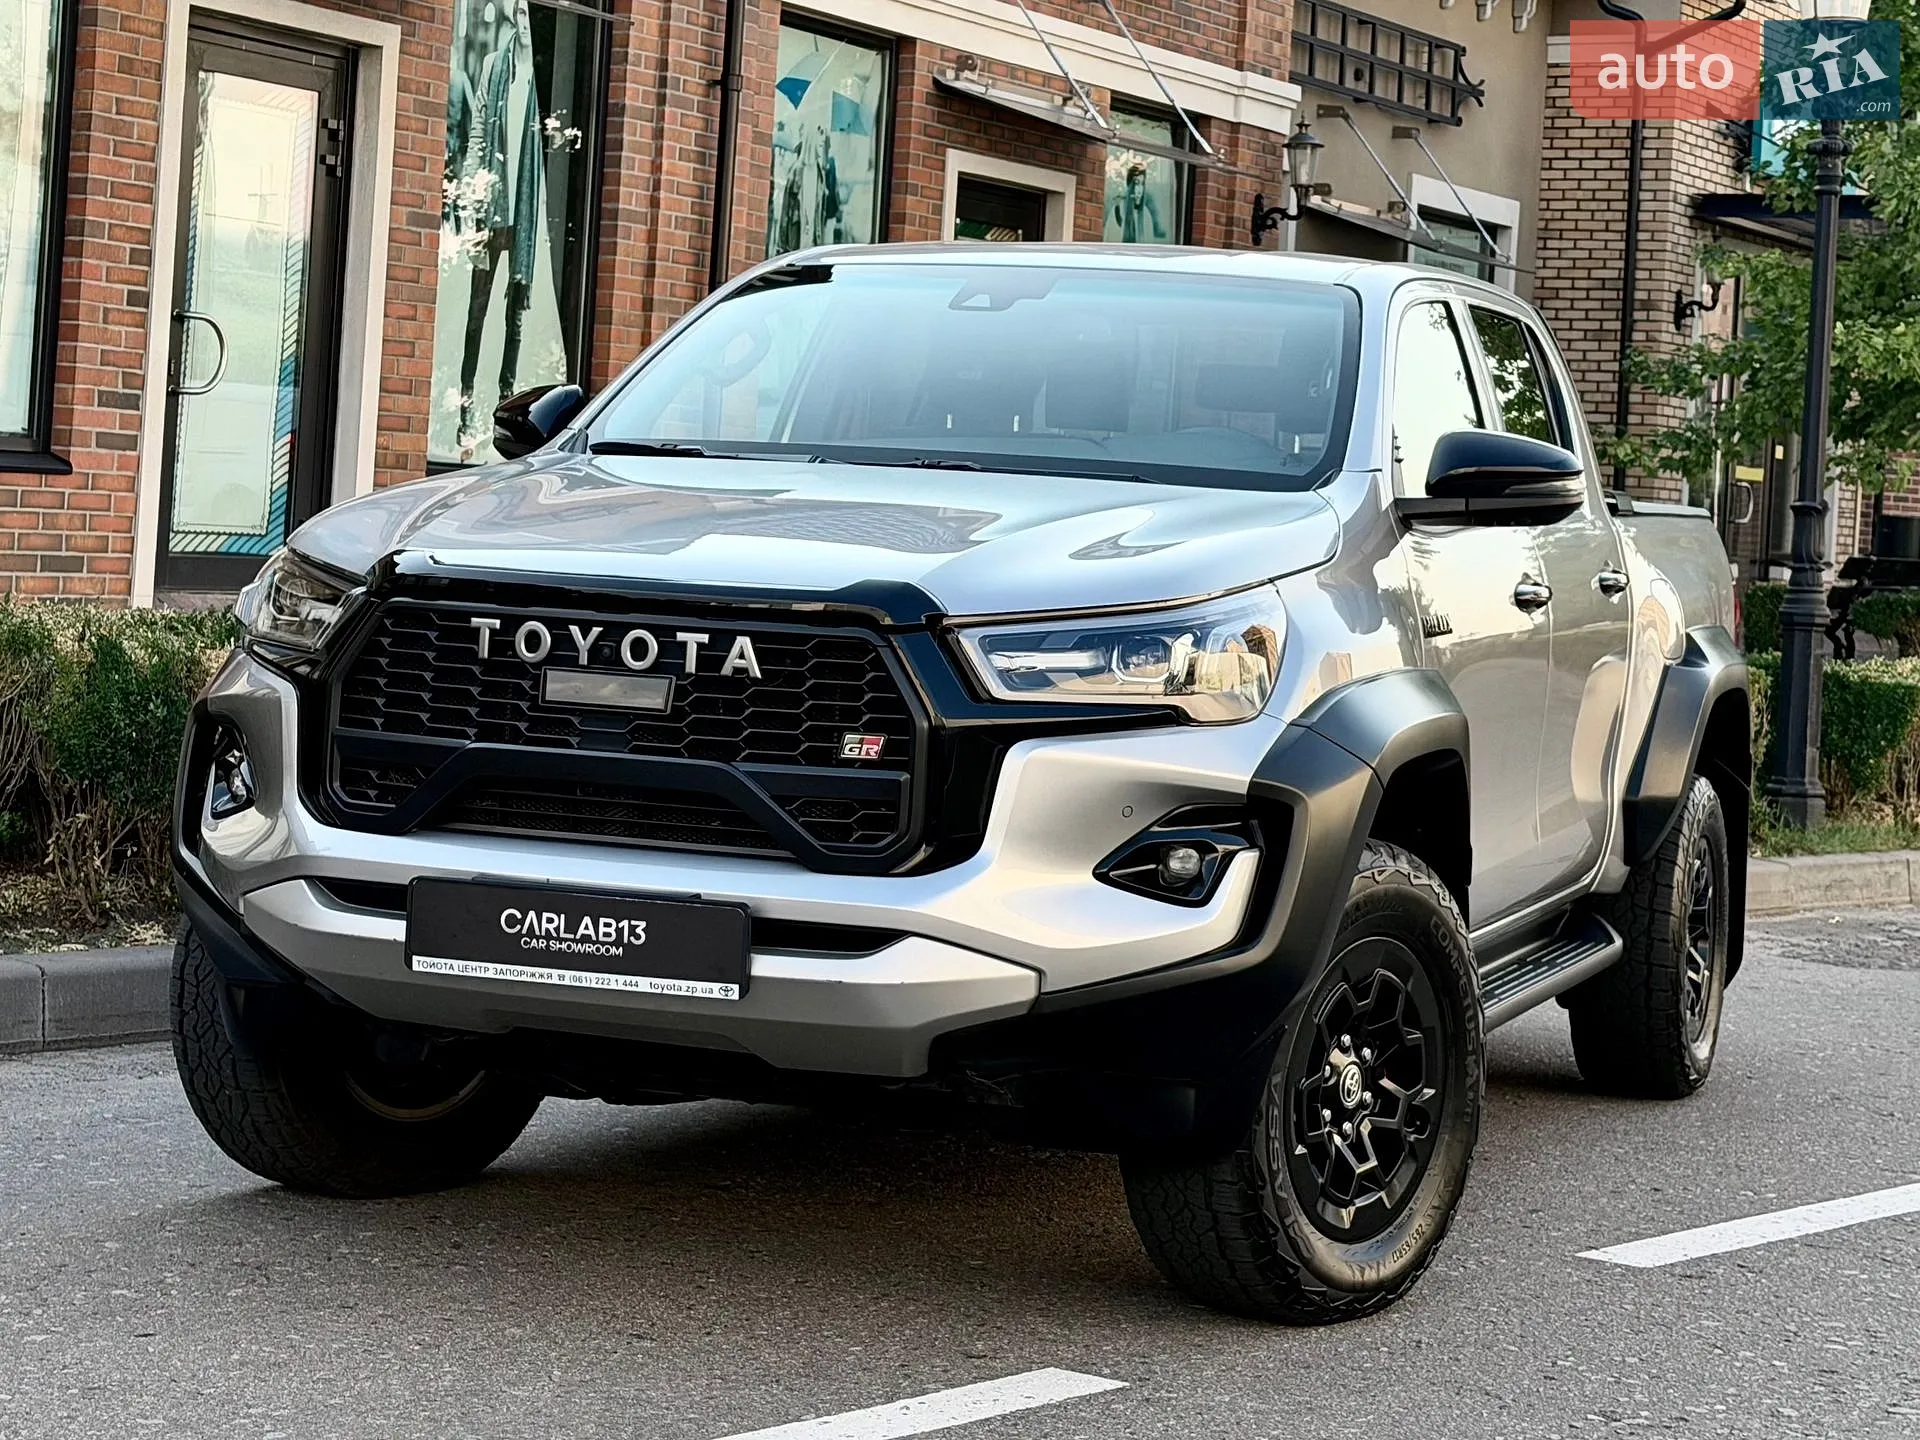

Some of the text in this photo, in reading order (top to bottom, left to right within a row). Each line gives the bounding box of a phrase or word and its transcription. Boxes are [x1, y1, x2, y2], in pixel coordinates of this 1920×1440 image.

[470, 617, 762, 679] TOYOTA
[843, 743, 880, 757] GR
[500, 908, 647, 945] CARLAB13
[520, 937, 624, 957] CAR SHOWROOM
[416, 959, 455, 972] ТОЙОТА
[457, 963, 490, 974] ЦЕНТР
[492, 967, 553, 980] ЗАПОРІЖЖЯ
[569, 975, 592, 985] (061)
[594, 976, 612, 986] 222
[622, 979, 640, 989] 444
[649, 982, 714, 995] toyota.zp.ua
